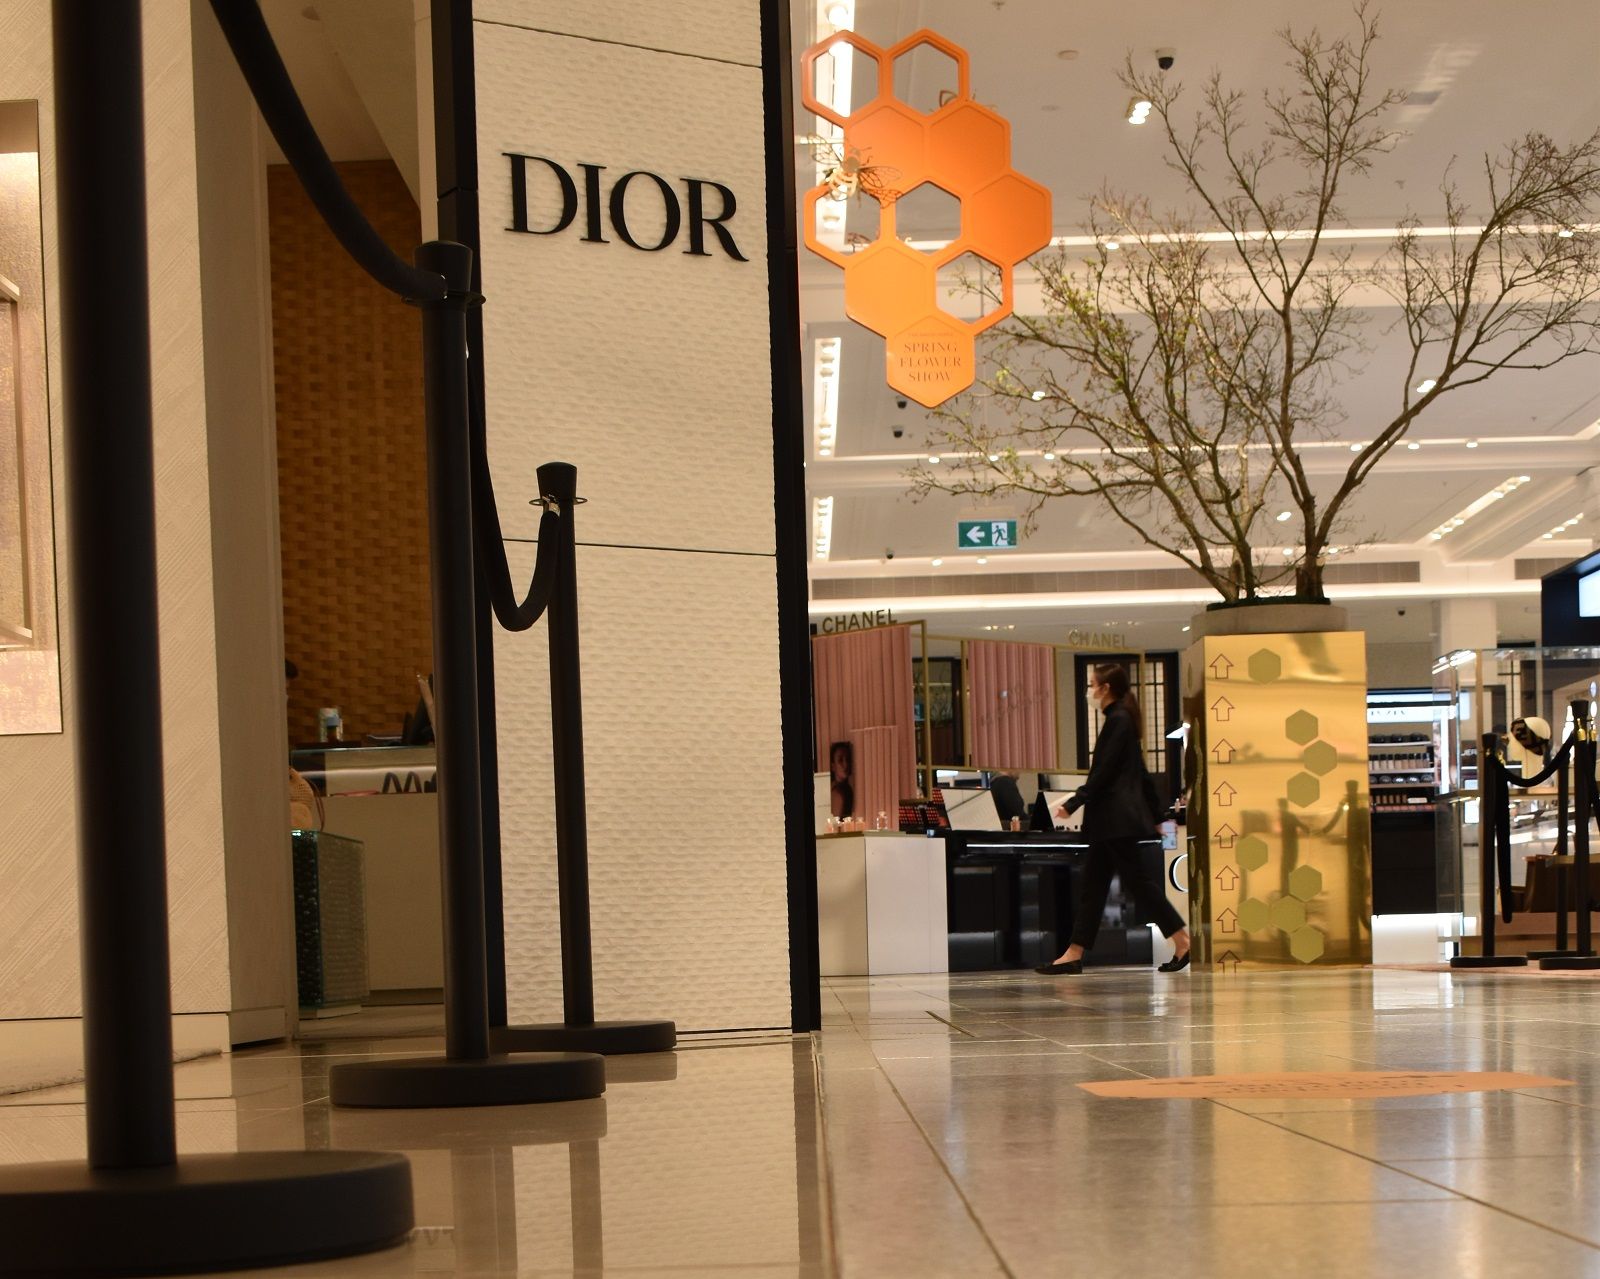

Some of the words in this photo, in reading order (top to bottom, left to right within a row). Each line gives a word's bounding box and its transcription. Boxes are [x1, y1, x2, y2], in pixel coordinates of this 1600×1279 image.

[502, 152, 749, 262] DIOR
[904, 342, 957, 353] SPRING
[900, 357, 961, 367] FLOWER
[908, 371, 951, 382] SHOW
[822, 608, 898, 633] CHANEL
[1068, 629, 1127, 649] CHANEL
